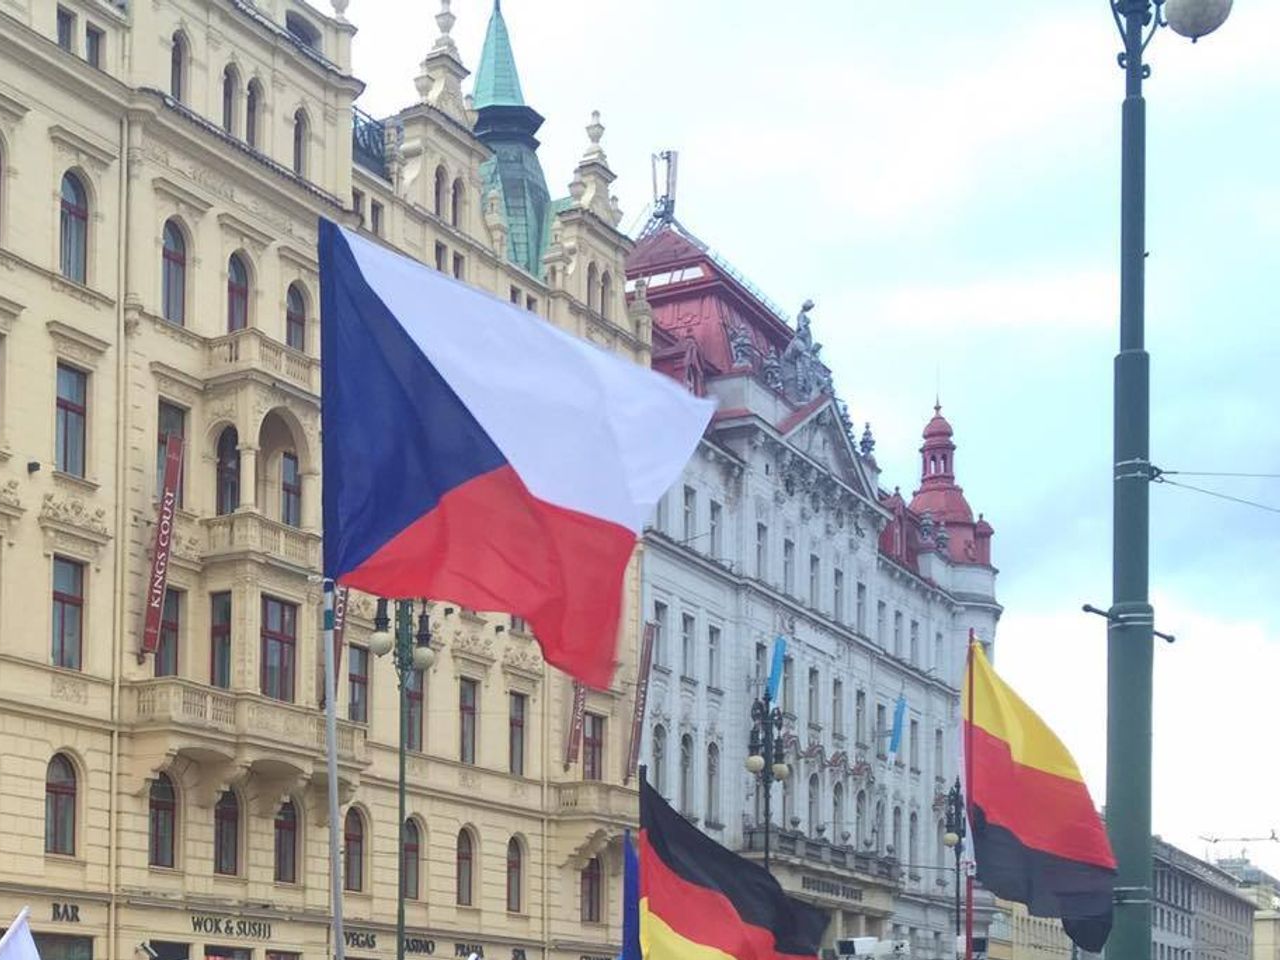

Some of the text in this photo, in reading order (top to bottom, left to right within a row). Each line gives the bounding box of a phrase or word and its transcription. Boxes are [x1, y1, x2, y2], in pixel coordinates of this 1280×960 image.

[151, 490, 175, 609] KINGS COURT
[52, 902, 80, 923] BAR
[192, 916, 271, 940] WOK & SUSHI
[344, 931, 376, 949] VEGAS
[403, 938, 435, 956] ASINO
